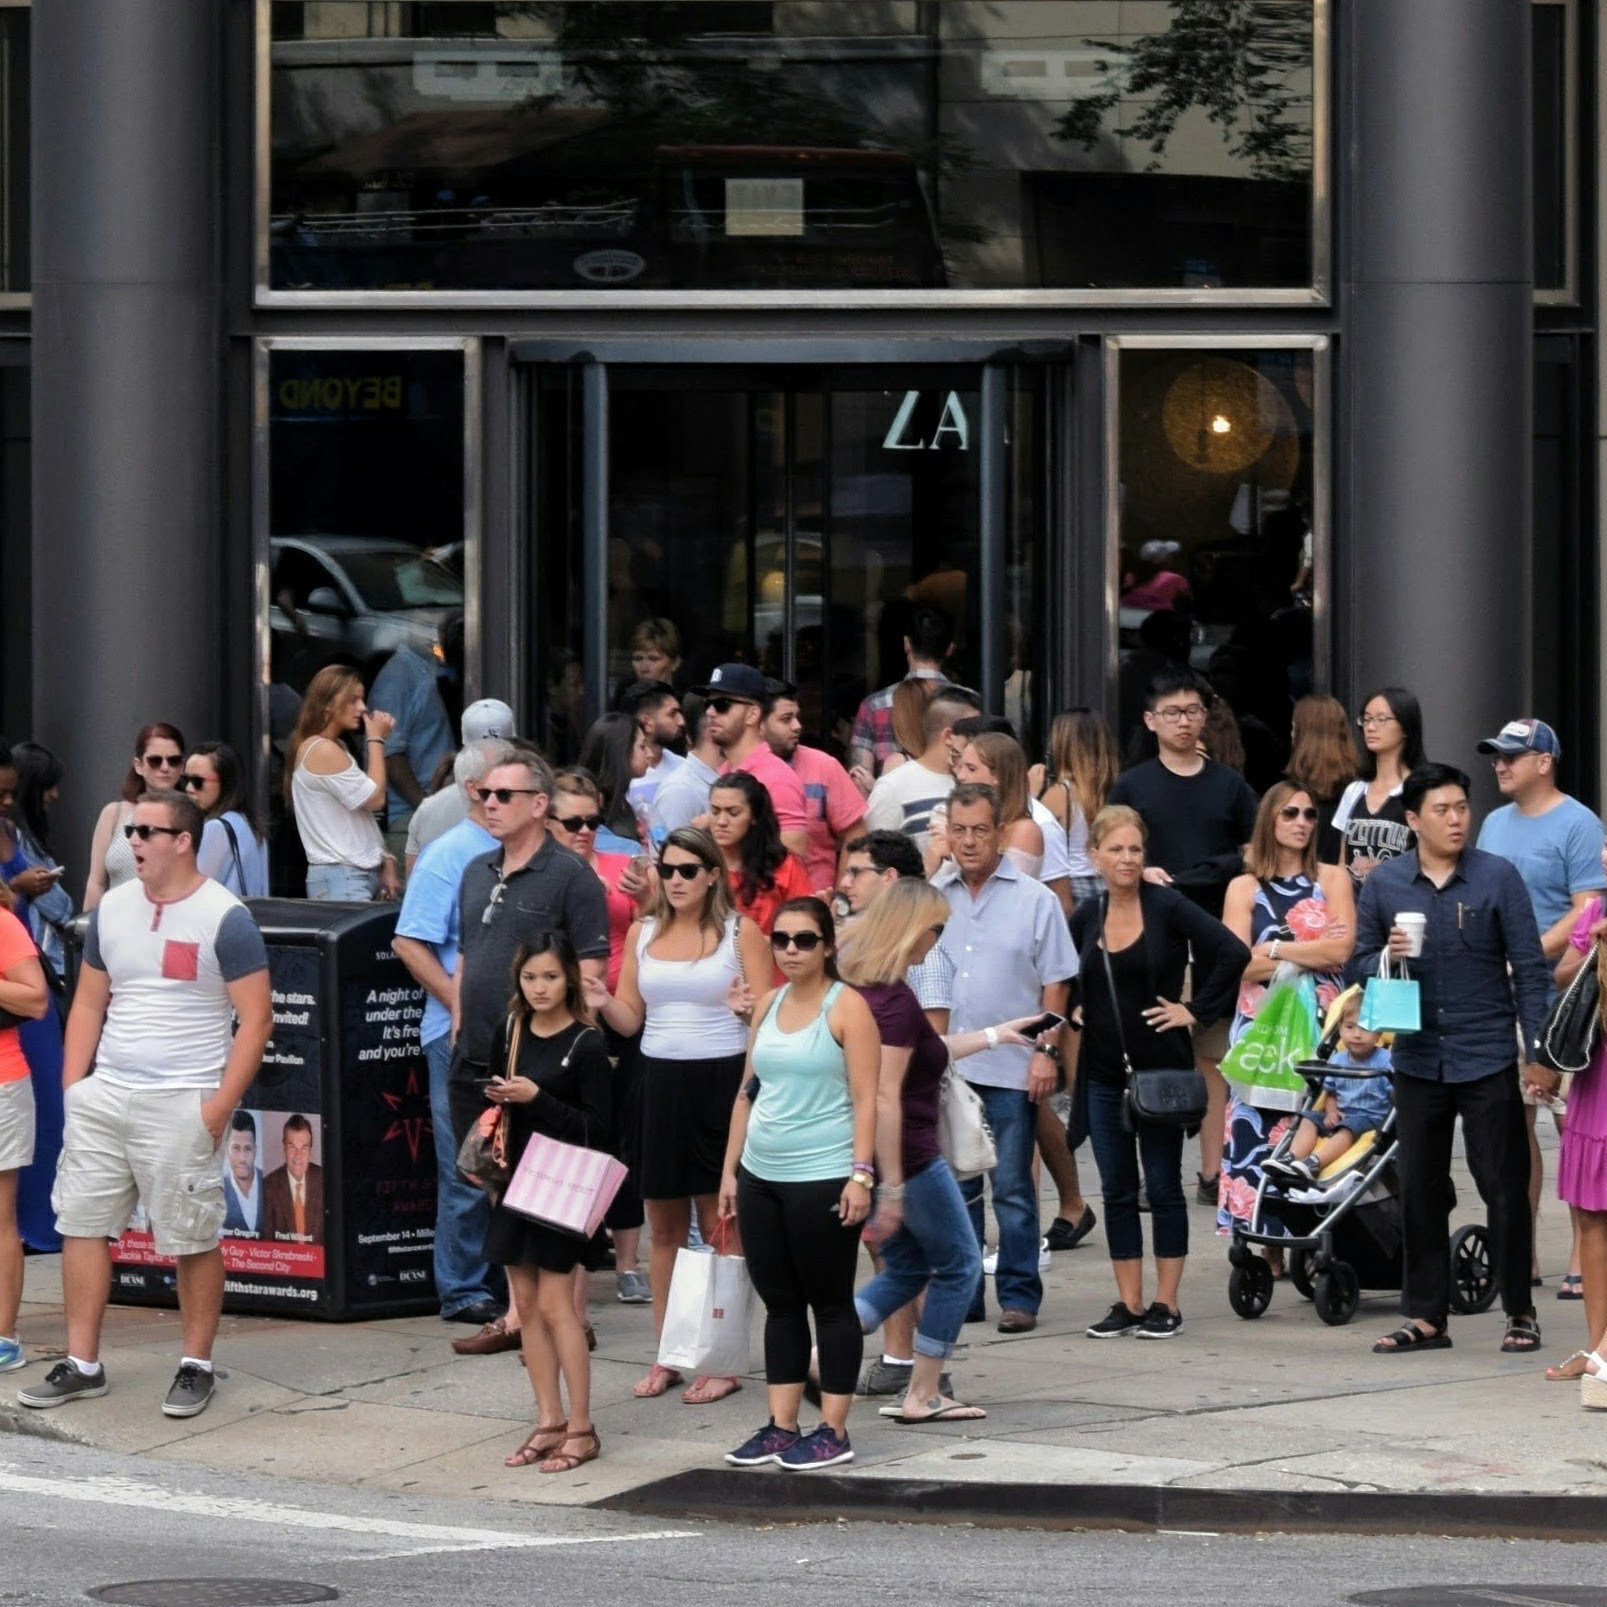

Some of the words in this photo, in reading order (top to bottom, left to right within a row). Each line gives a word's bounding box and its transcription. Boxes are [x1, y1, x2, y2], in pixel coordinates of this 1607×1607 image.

[376, 951, 401, 960] SOLA
[286, 991, 317, 1005] stars.
[366, 990, 377, 1004] A
[379, 988, 410, 1004] night
[411, 988, 424, 1000] of
[366, 1008, 401, 1022] under
[403, 1007, 422, 1019] the
[383, 1026, 400, 1040] It's
[402, 1025, 421, 1038] fre
[276, 1054, 304, 1065] Pavilion
[358, 1046, 382, 1061] and
[384, 1044, 420, 1061] you're
[234, 1228, 259, 1239] Gregory
[275, 1231, 289, 1240] Fred
[358, 1232, 400, 1244] September
[401, 1230, 410, 1239] 14
[118, 1250, 141, 1261] Jackie
[229, 1245, 245, 1258] Guy
[249, 1247, 272, 1259] Victor
[232, 1258, 245, 1268] The
[247, 1260, 274, 1271] Second
[275, 1261, 291, 1274] City
